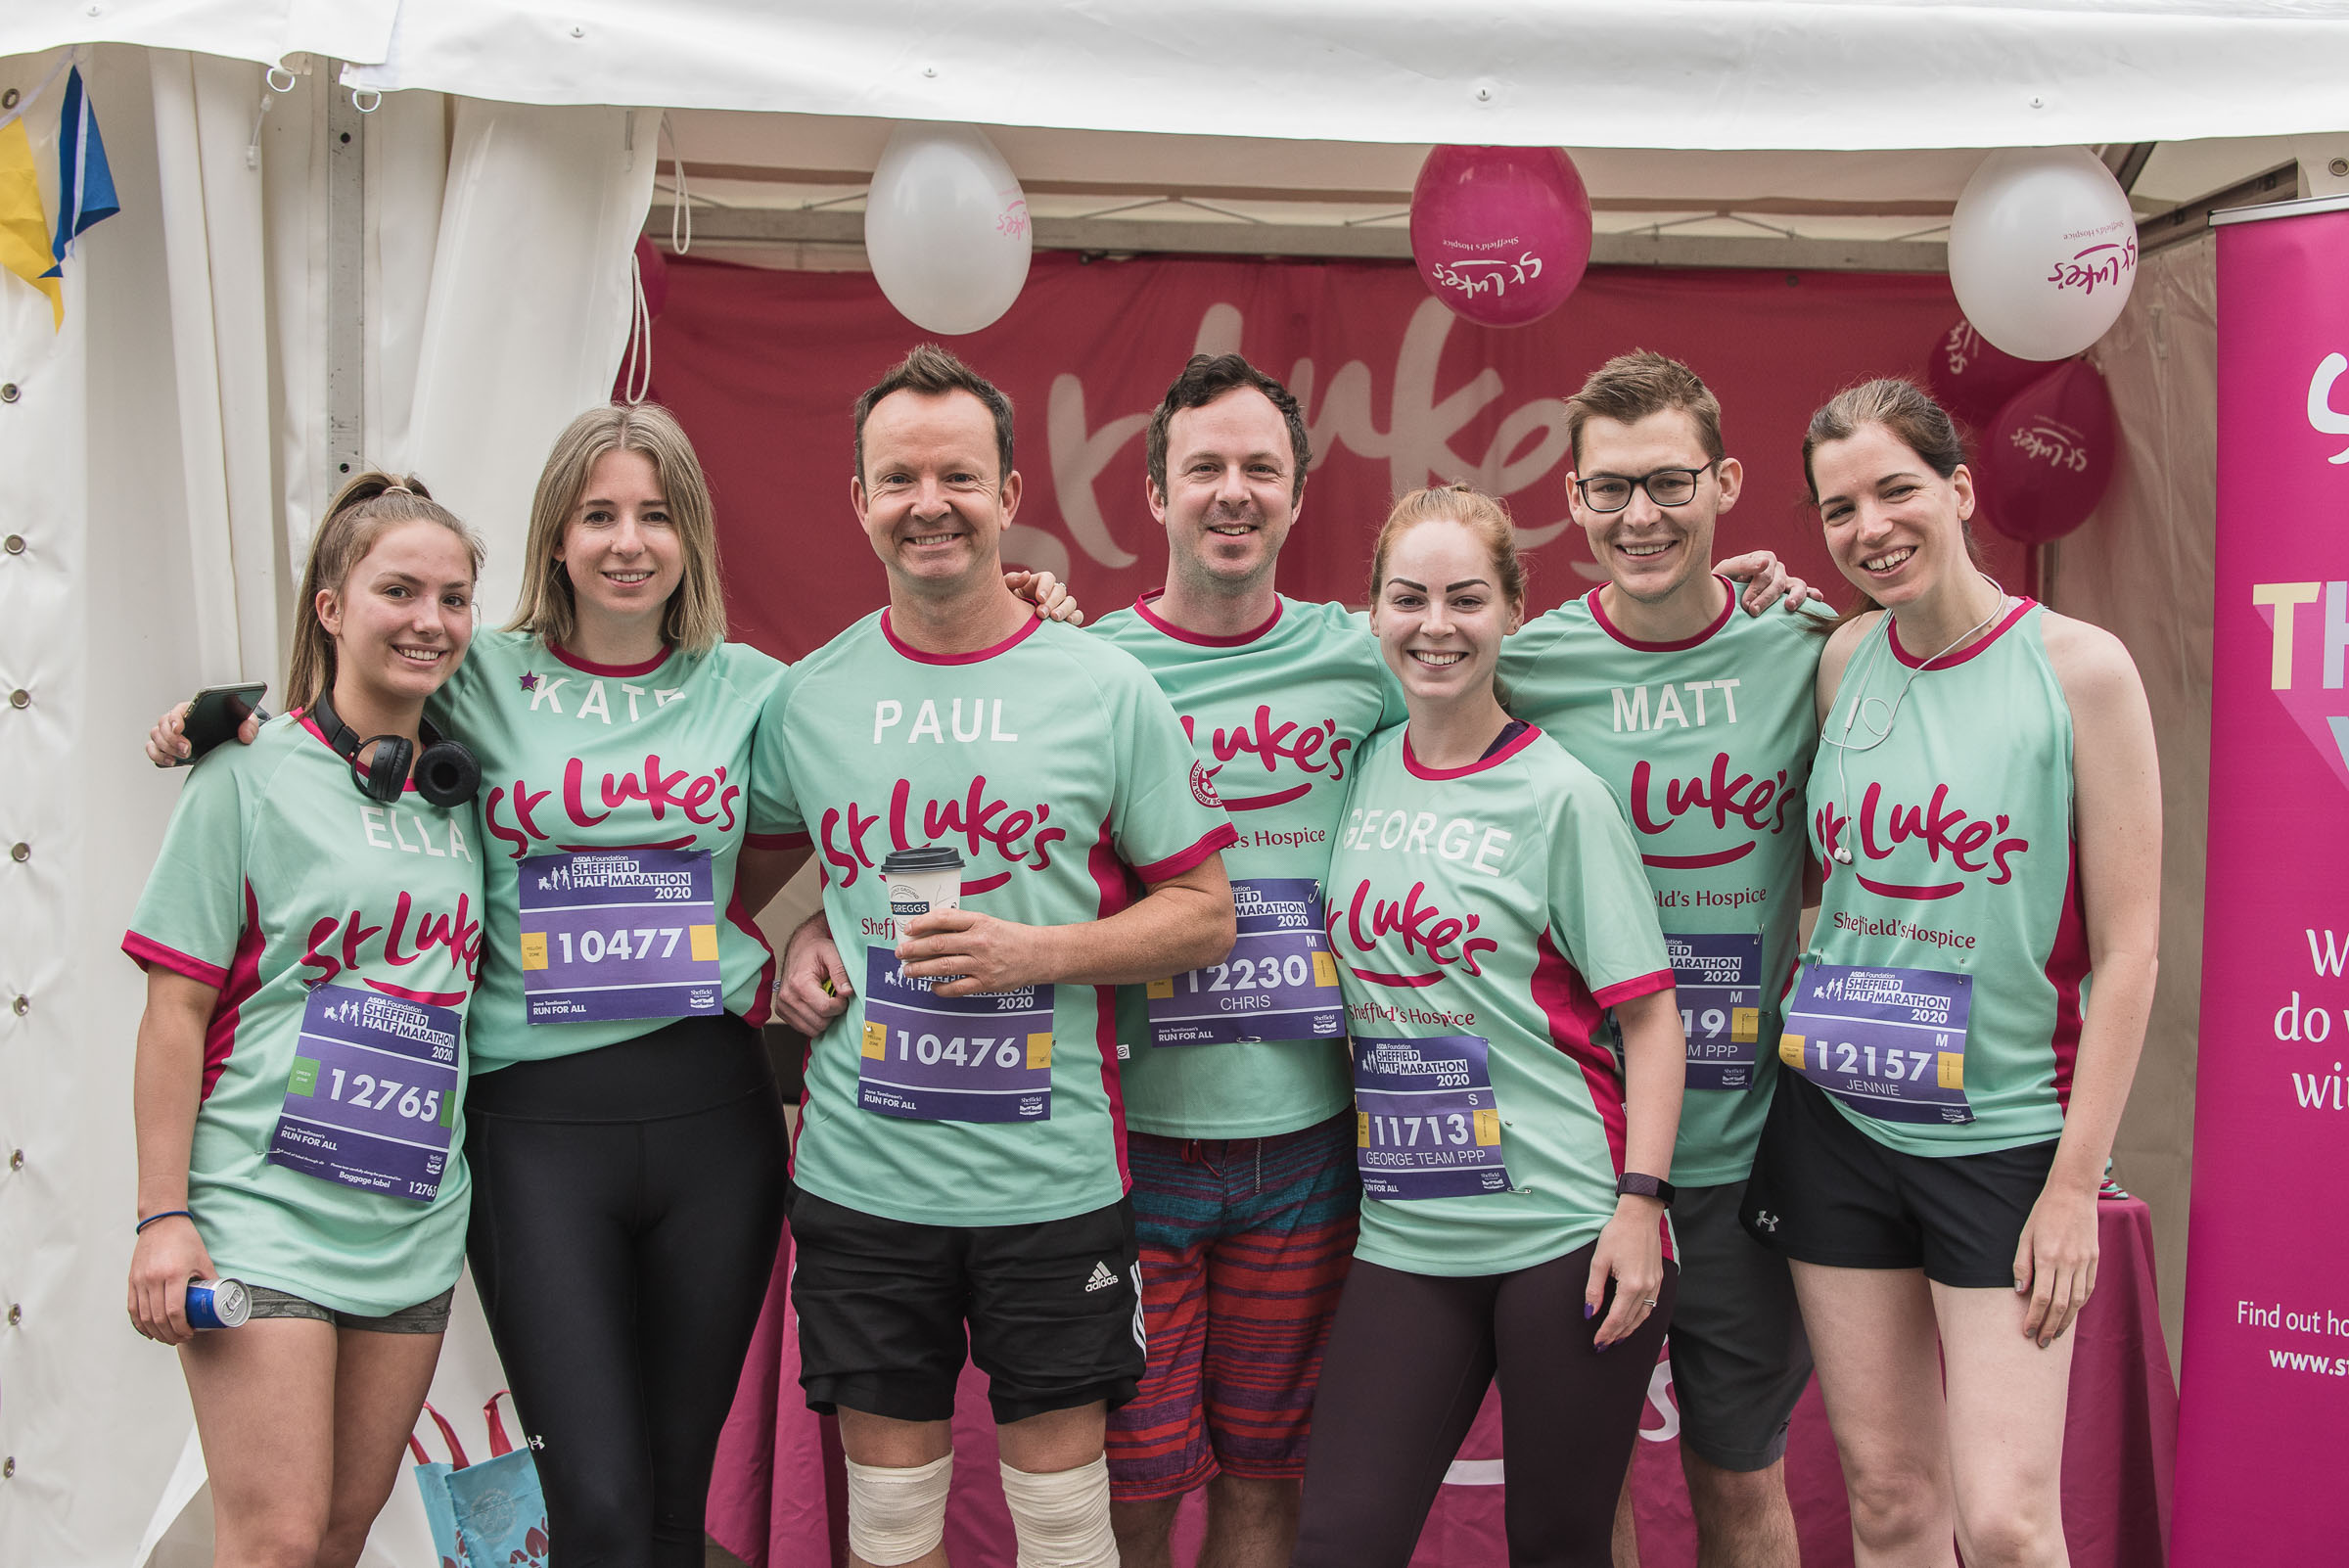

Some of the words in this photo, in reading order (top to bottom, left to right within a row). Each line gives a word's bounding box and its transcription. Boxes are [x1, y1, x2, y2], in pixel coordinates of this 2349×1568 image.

[1476, 236, 1519, 251] Sheffield's
[2063, 229, 2095, 241] Hospice
[1443, 238, 1474, 252] Hospice
[2121, 235, 2136, 271] St
[1509, 251, 1543, 285] St
[2048, 256, 2119, 295] Luke's
[1432, 262, 1505, 300] Luke's
[2307, 351, 2349, 465] S
[2010, 427, 2063, 467] Luke's
[2063, 448, 2088, 472] St
[1611, 678, 1741, 733] MATT
[873, 698, 1019, 745] PAUL
[1192, 763, 1203, 787] RECYC
[1194, 788, 1212, 805] FROM
[1631, 752, 1797, 835] Luke's
[485, 780, 551, 858] St
[563, 754, 741, 834] Luke's
[360, 806, 474, 863] ELLA
[820, 801, 880, 889] St
[890, 774, 1067, 872] Luke's
[1255, 826, 1326, 849] Hospice
[1860, 782, 2029, 886] Luke's
[1343, 808, 1512, 877] GEORGE
[573, 862, 638, 875] SHEFFIELD
[574, 876, 608, 889] HALF
[610, 873, 690, 887] MARATHON
[654, 887, 692, 899] 2020
[1233, 892, 1260, 904] IELD
[1654, 891, 1690, 908] eld's
[1696, 887, 1767, 909] Hospice
[893, 903, 928, 913] GREGGS
[1235, 902, 1306, 916] MARATHON
[861, 917, 896, 941] Sheff
[1277, 914, 1310, 927] 2020
[1325, 898, 1344, 960] t
[1349, 879, 1498, 978] Luke's
[299, 909, 383, 987] St
[384, 891, 483, 982] Luke
[1306, 935, 1317, 948] M
[1906, 922, 1976, 949] Hospice
[558, 927, 684, 964] 10477
[1668, 946, 1689, 957] ELD
[1188, 954, 1309, 992] 12230
[1703, 970, 1740, 983] 2020
[1847, 978, 1902, 992] SHEFFIELD
[367, 996, 387, 1006] ASDA
[387, 999, 422, 1014] Foundation
[996, 996, 1034, 1010] 2020
[1220, 994, 1271, 1011] CHRIS
[1729, 992, 1742, 1003] M
[1844, 991, 1873, 1002] HALF
[1873, 992, 1949, 1010] MARATHON
[364, 1003, 428, 1027] SHEFFIELD
[533, 1007, 551, 1016] RUN
[571, 1004, 587, 1013] ALL
[1408, 1007, 1476, 1028] Hospice
[1911, 1008, 1948, 1025] 2020
[2274, 991, 2330, 1043] do
[362, 1015, 398, 1034] HALF
[397, 1024, 455, 1048] MARATHON
[1681, 1008, 1726, 1039] 19
[1159, 1033, 1177, 1041] RUN
[1178, 1032, 1196, 1040] FOR
[1935, 1034, 1949, 1047] M
[432, 1045, 454, 1062] 2020
[897, 1030, 1021, 1069] 10476
[1376, 1050, 1419, 1062] SHEFFIELD
[1686, 1044, 1701, 1057] M
[1706, 1044, 1738, 1057] PPP
[1378, 1062, 1400, 1075] HALF
[1401, 1060, 1467, 1075] MARATHON
[1816, 1039, 1933, 1082] 12157
[1436, 1074, 1470, 1086] 2020
[1846, 1080, 1901, 1097] JENNIE
[2291, 1061, 2349, 1111] wi
[330, 1067, 439, 1123] 12765
[864, 1094, 882, 1105] RUN
[883, 1097, 899, 1107] FOR
[900, 1101, 917, 1110] ALL
[876, 1090, 903, 1100] Tomlinson's
[1468, 1093, 1479, 1106] S
[297, 1128, 326, 1139] Tomlinson's
[1374, 1114, 1469, 1147] 11713
[281, 1130, 301, 1142] RUN
[301, 1135, 320, 1147] FOR
[321, 1140, 338, 1151] ALL
[1365, 1152, 1415, 1166] GEORGE
[1416, 1151, 1455, 1165] TEAM
[1458, 1150, 1486, 1163] PPP
[339, 1171, 372, 1184] Baggage
[372, 1177, 391, 1188] label
[408, 1181, 437, 1198] 12765
[1084, 1274, 1119, 1293] adidas
[2237, 1300, 2280, 1329] Find
[2285, 1311, 2322, 1334] out
[2269, 1349, 2349, 1377] www.s
